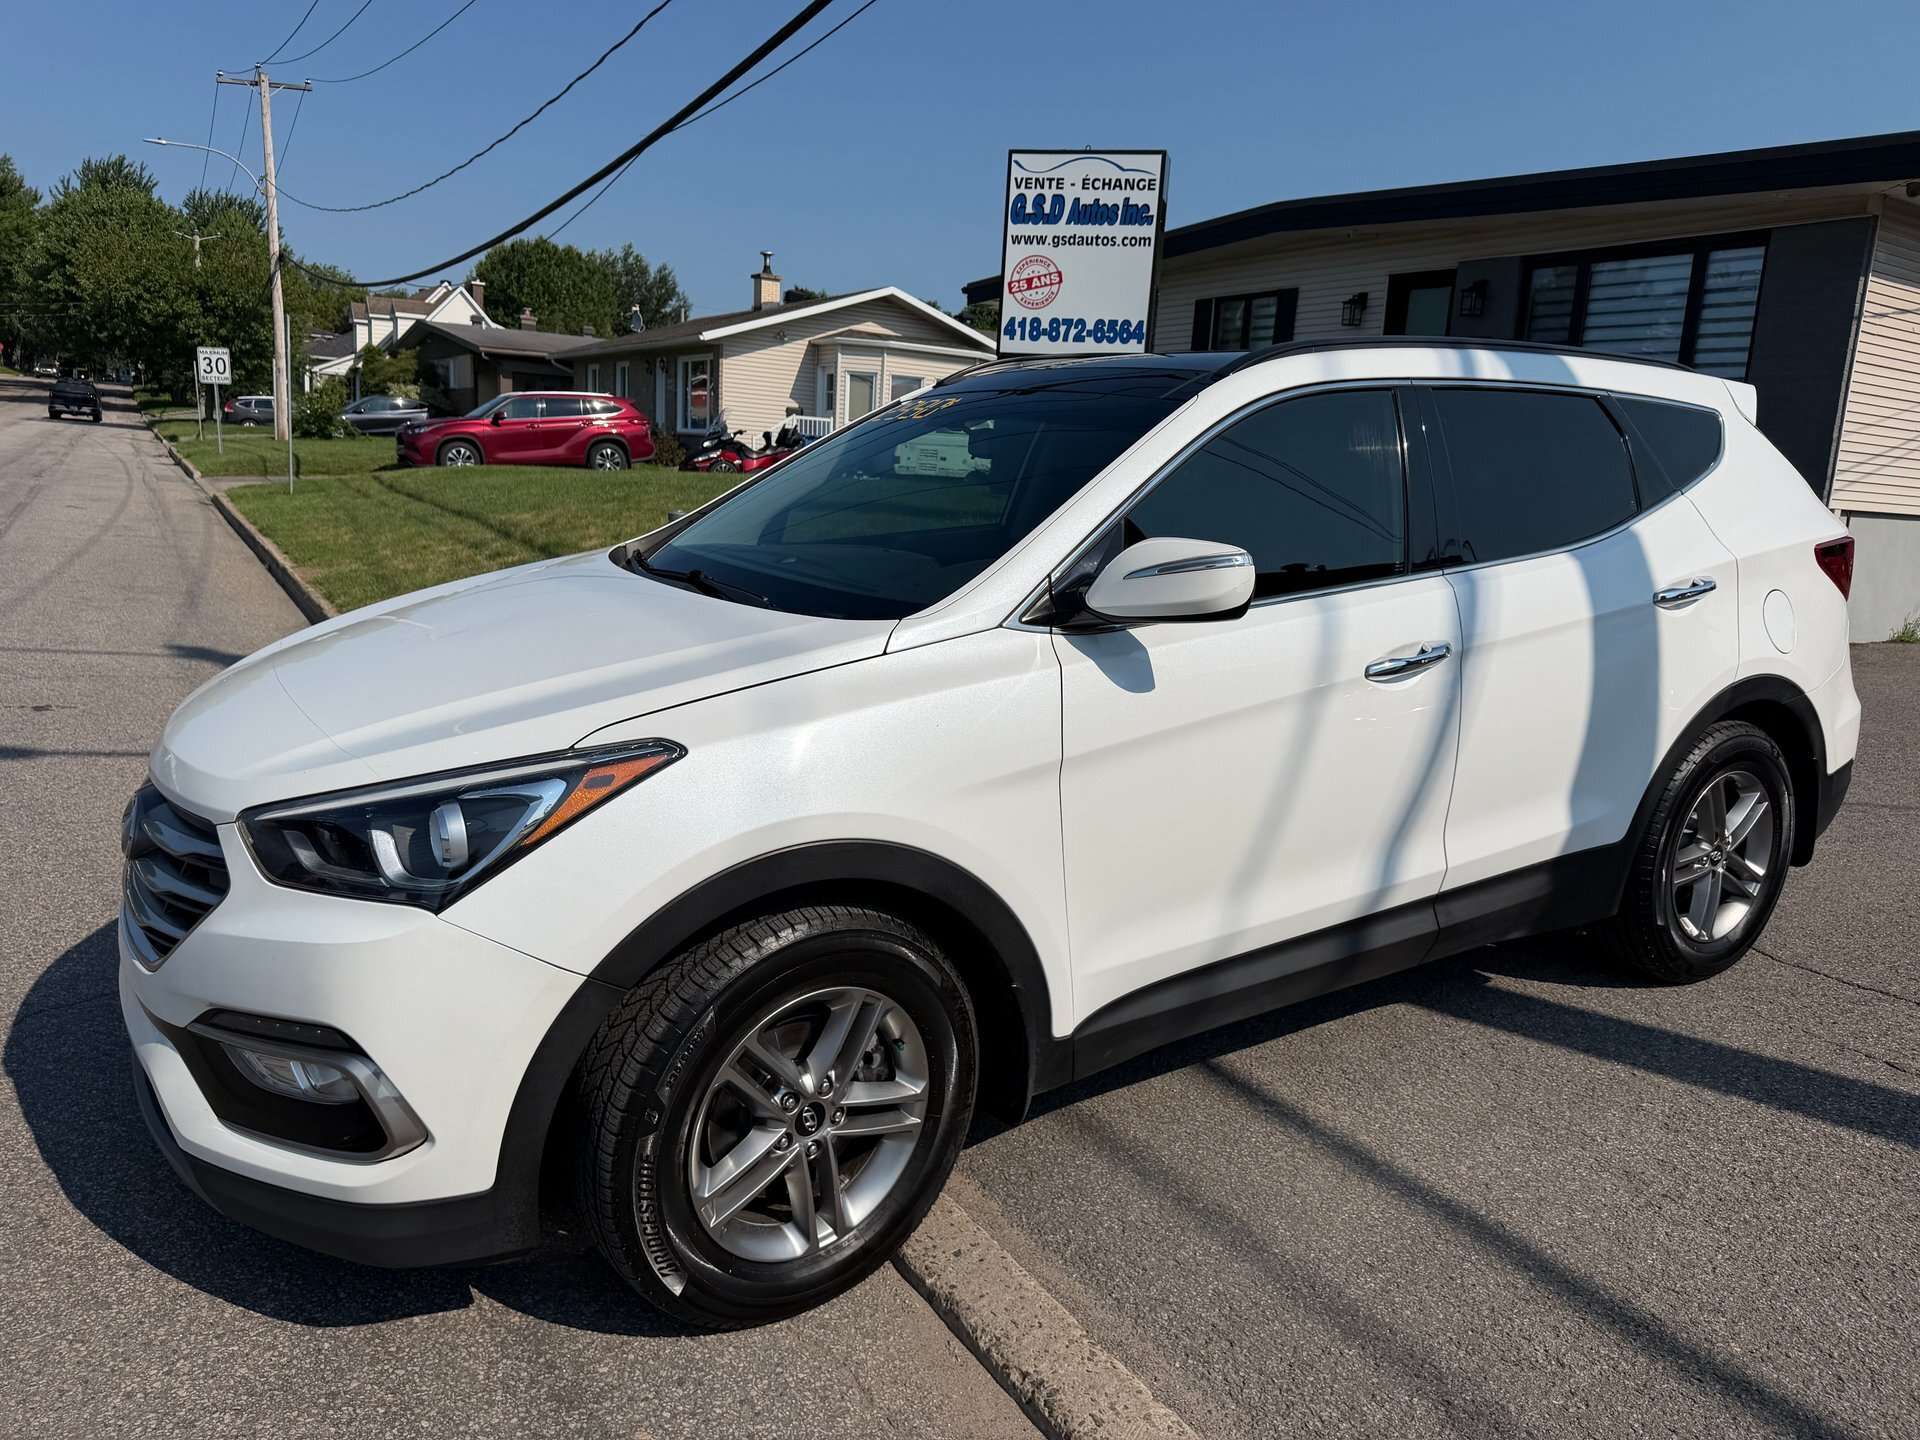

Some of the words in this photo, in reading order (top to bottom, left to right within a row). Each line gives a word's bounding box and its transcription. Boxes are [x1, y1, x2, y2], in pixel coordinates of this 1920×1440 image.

[1014, 177, 1065, 190] VENTE
[1081, 174, 1156, 191] ÉCHANGE
[1010, 193, 1066, 225] G.S.D
[1065, 197, 1119, 226] Autos
[1011, 233, 1152, 247] www.gsdautos.com
[1011, 280, 1028, 293] 25
[1031, 273, 1060, 288] ANS
[1004, 317, 1145, 344] 418-872-6564
[203, 357, 226, 374] 30
